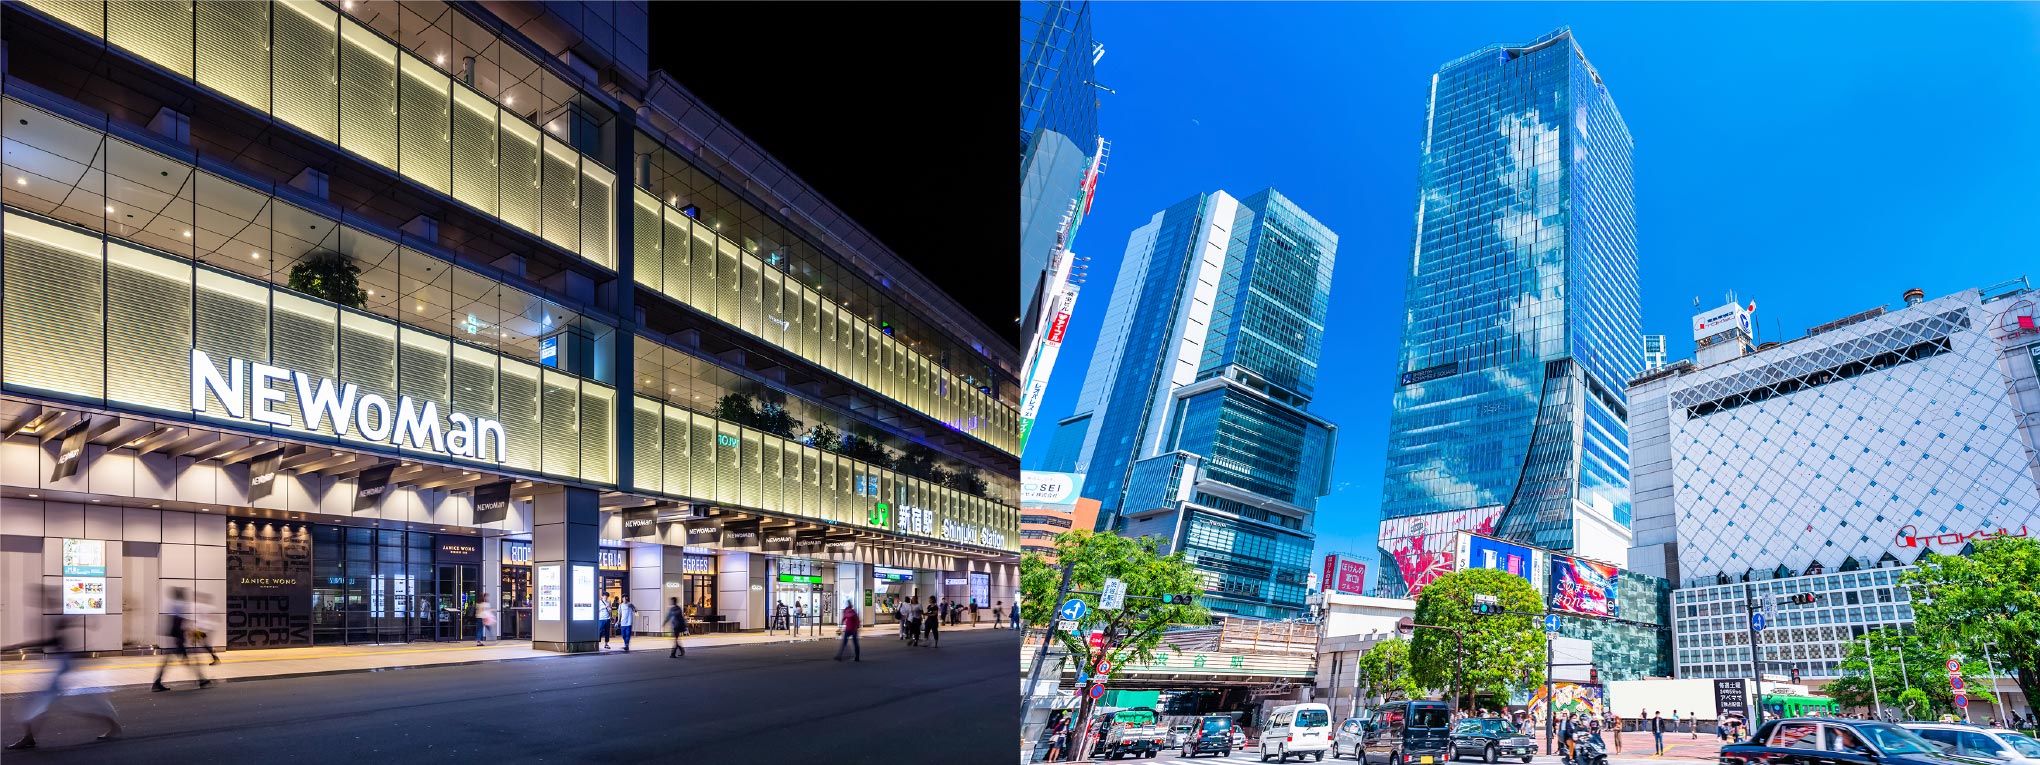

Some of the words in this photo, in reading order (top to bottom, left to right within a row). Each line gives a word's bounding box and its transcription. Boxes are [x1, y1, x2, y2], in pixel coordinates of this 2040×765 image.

[869, 502, 889, 527] JR
[899, 503, 933, 535] 新宿駅
[943, 518, 977, 545] Shinjuku
[981, 527, 1005, 548] Station
[1341, 562, 1365, 575] ほけんの
[241, 577, 270, 585] JANICE
[1341, 583, 1360, 591] グループ
[1153, 652, 1245, 669] 渋谷駅
